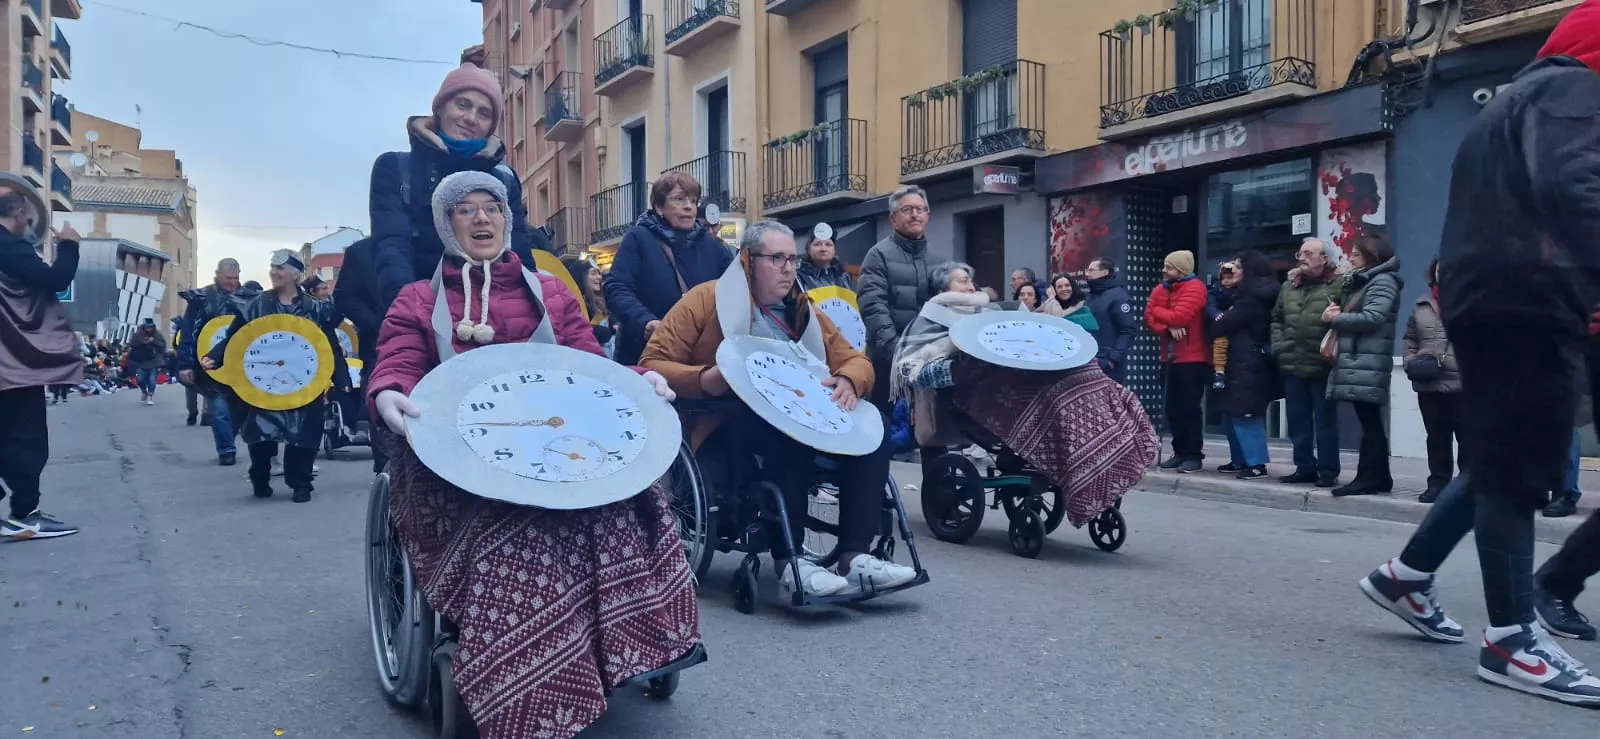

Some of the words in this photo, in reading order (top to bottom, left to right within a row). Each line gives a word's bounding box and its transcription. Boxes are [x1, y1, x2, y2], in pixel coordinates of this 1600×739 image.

[519, 374, 545, 384] 12
[566, 376, 575, 385] 1
[491, 383, 510, 393] 11
[593, 389, 613, 398] 2
[470, 401, 495, 412] 10
[615, 407, 634, 419] 3
[469, 427, 488, 438] 9
[620, 430, 638, 441] 4
[494, 448, 514, 461] 8
[607, 449, 624, 462] 5
[530, 462, 546, 474] 7
